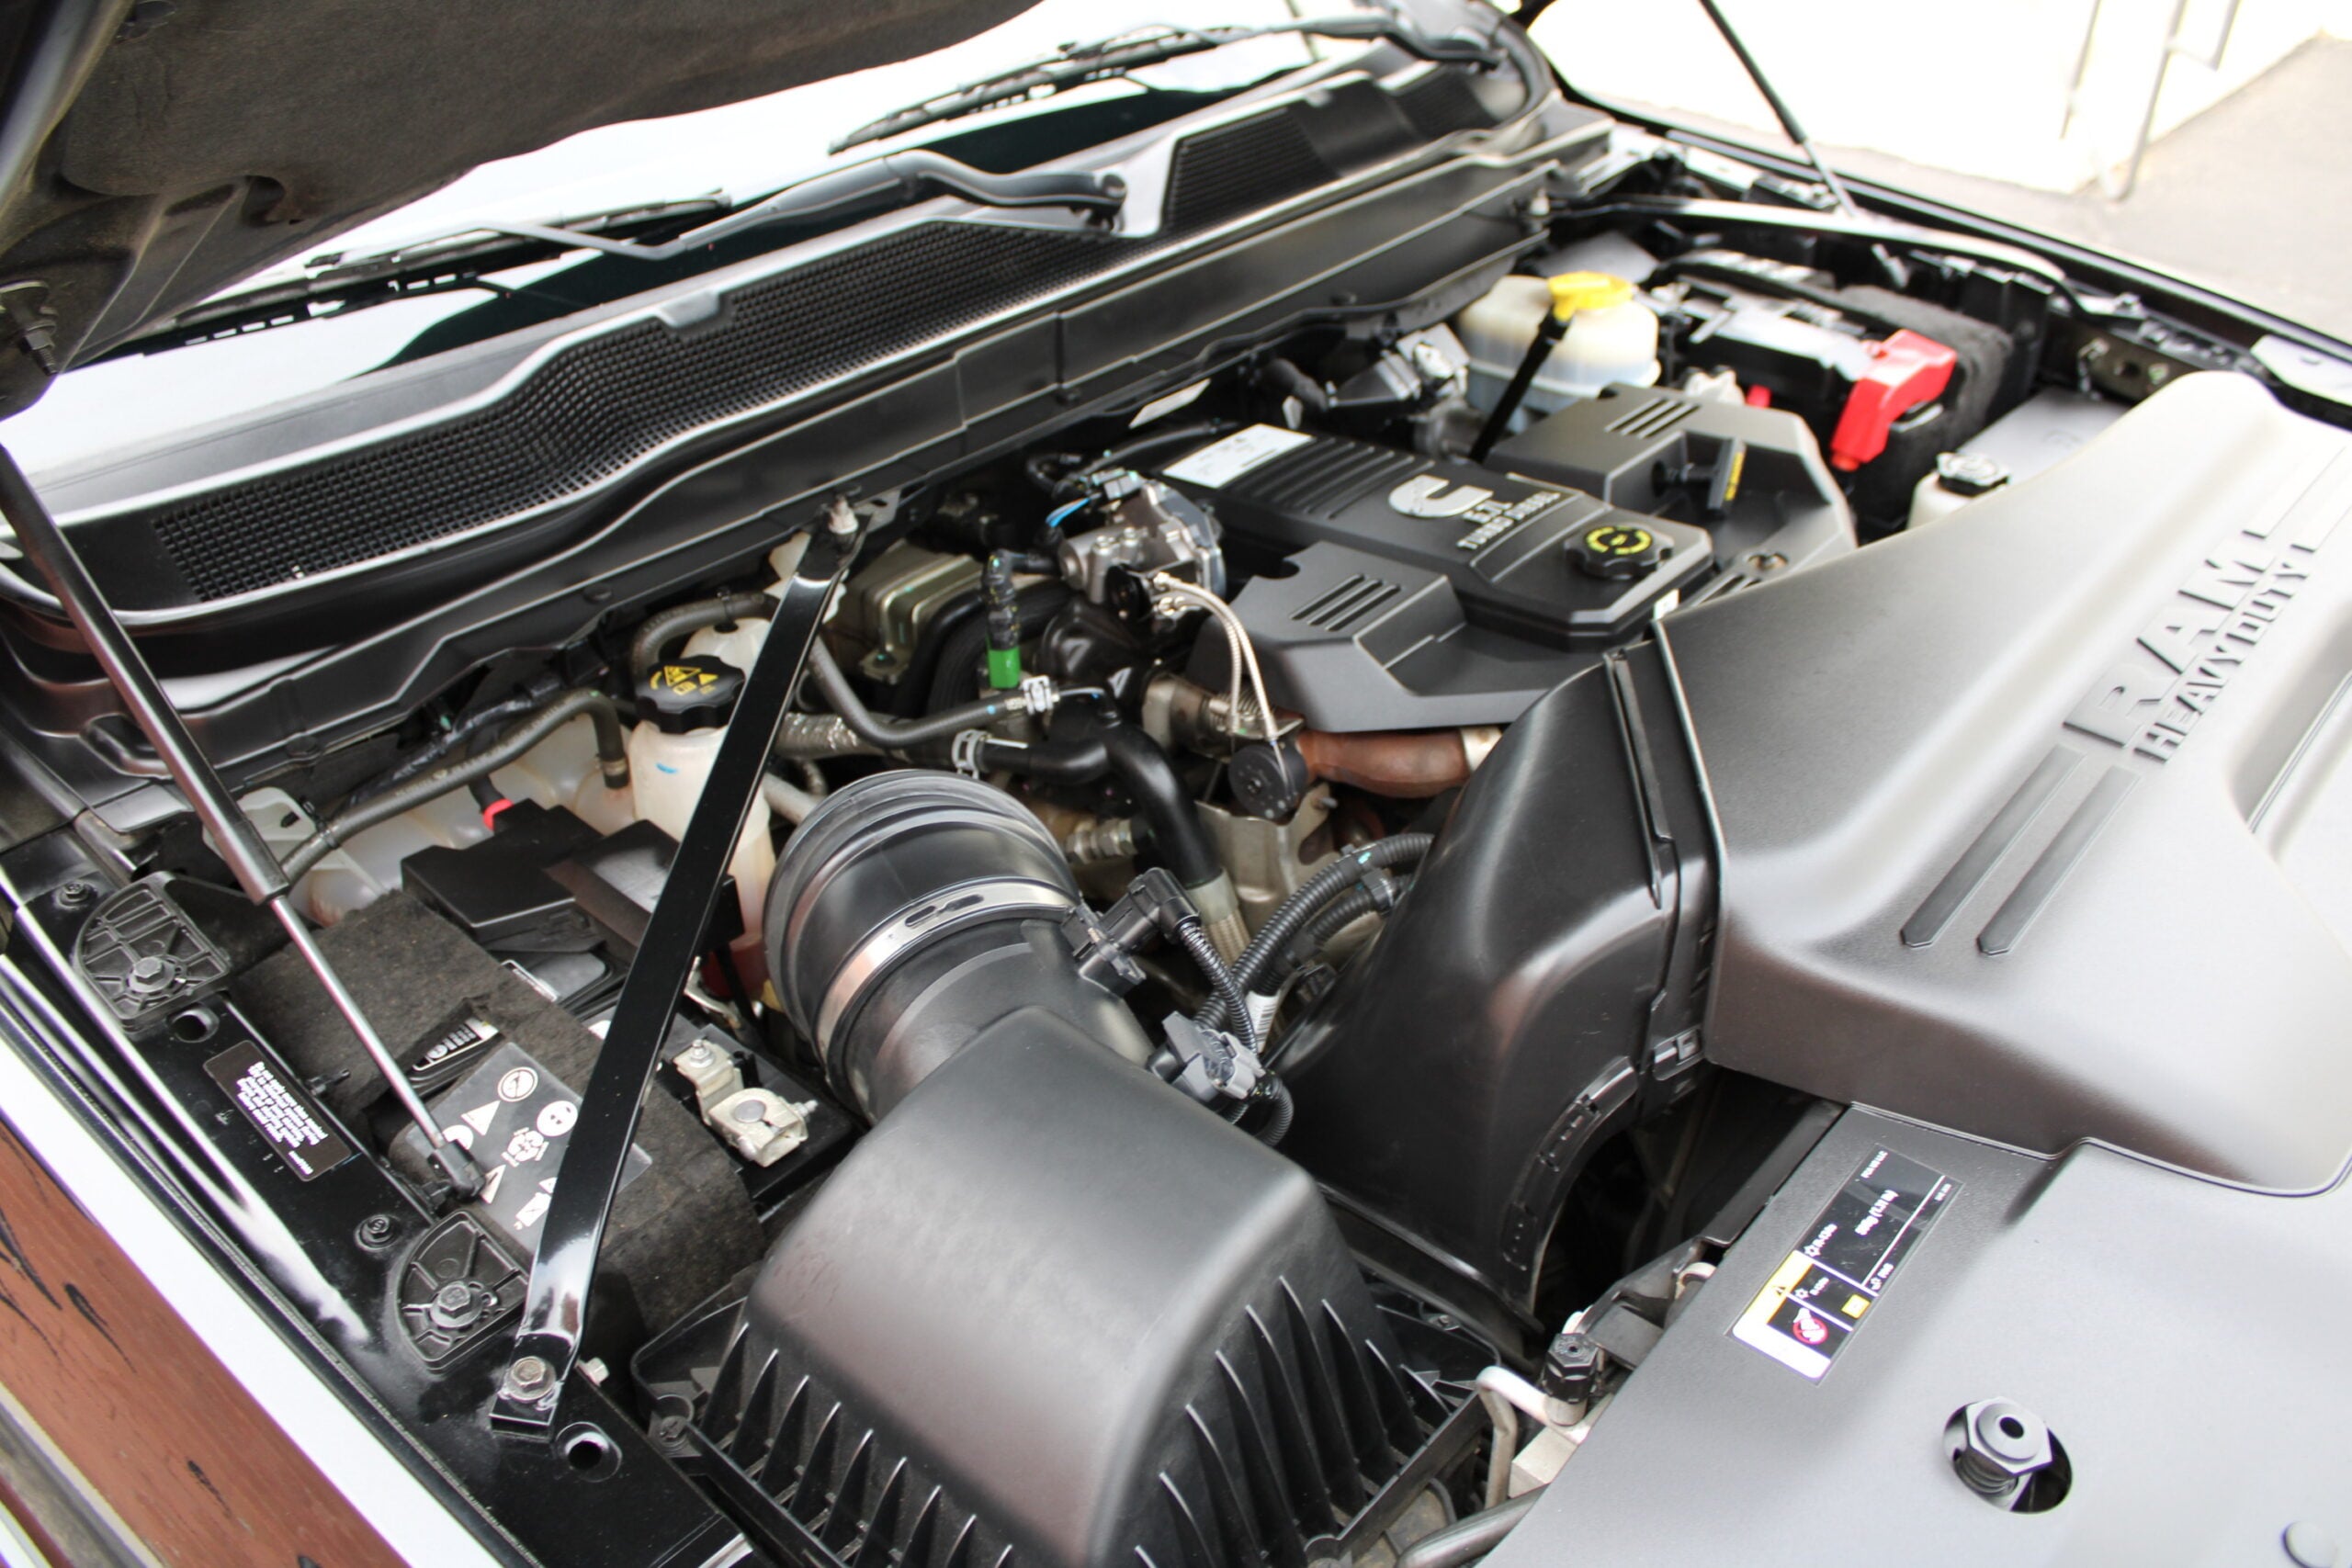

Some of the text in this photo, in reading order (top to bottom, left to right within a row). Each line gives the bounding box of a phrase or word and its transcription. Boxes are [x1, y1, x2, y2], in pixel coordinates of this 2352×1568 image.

[1456, 491, 1561, 550] TURBO DIESEL
[2063, 542, 2273, 749] RAM
[2134, 561, 2309, 764] HEAVY DUTY
